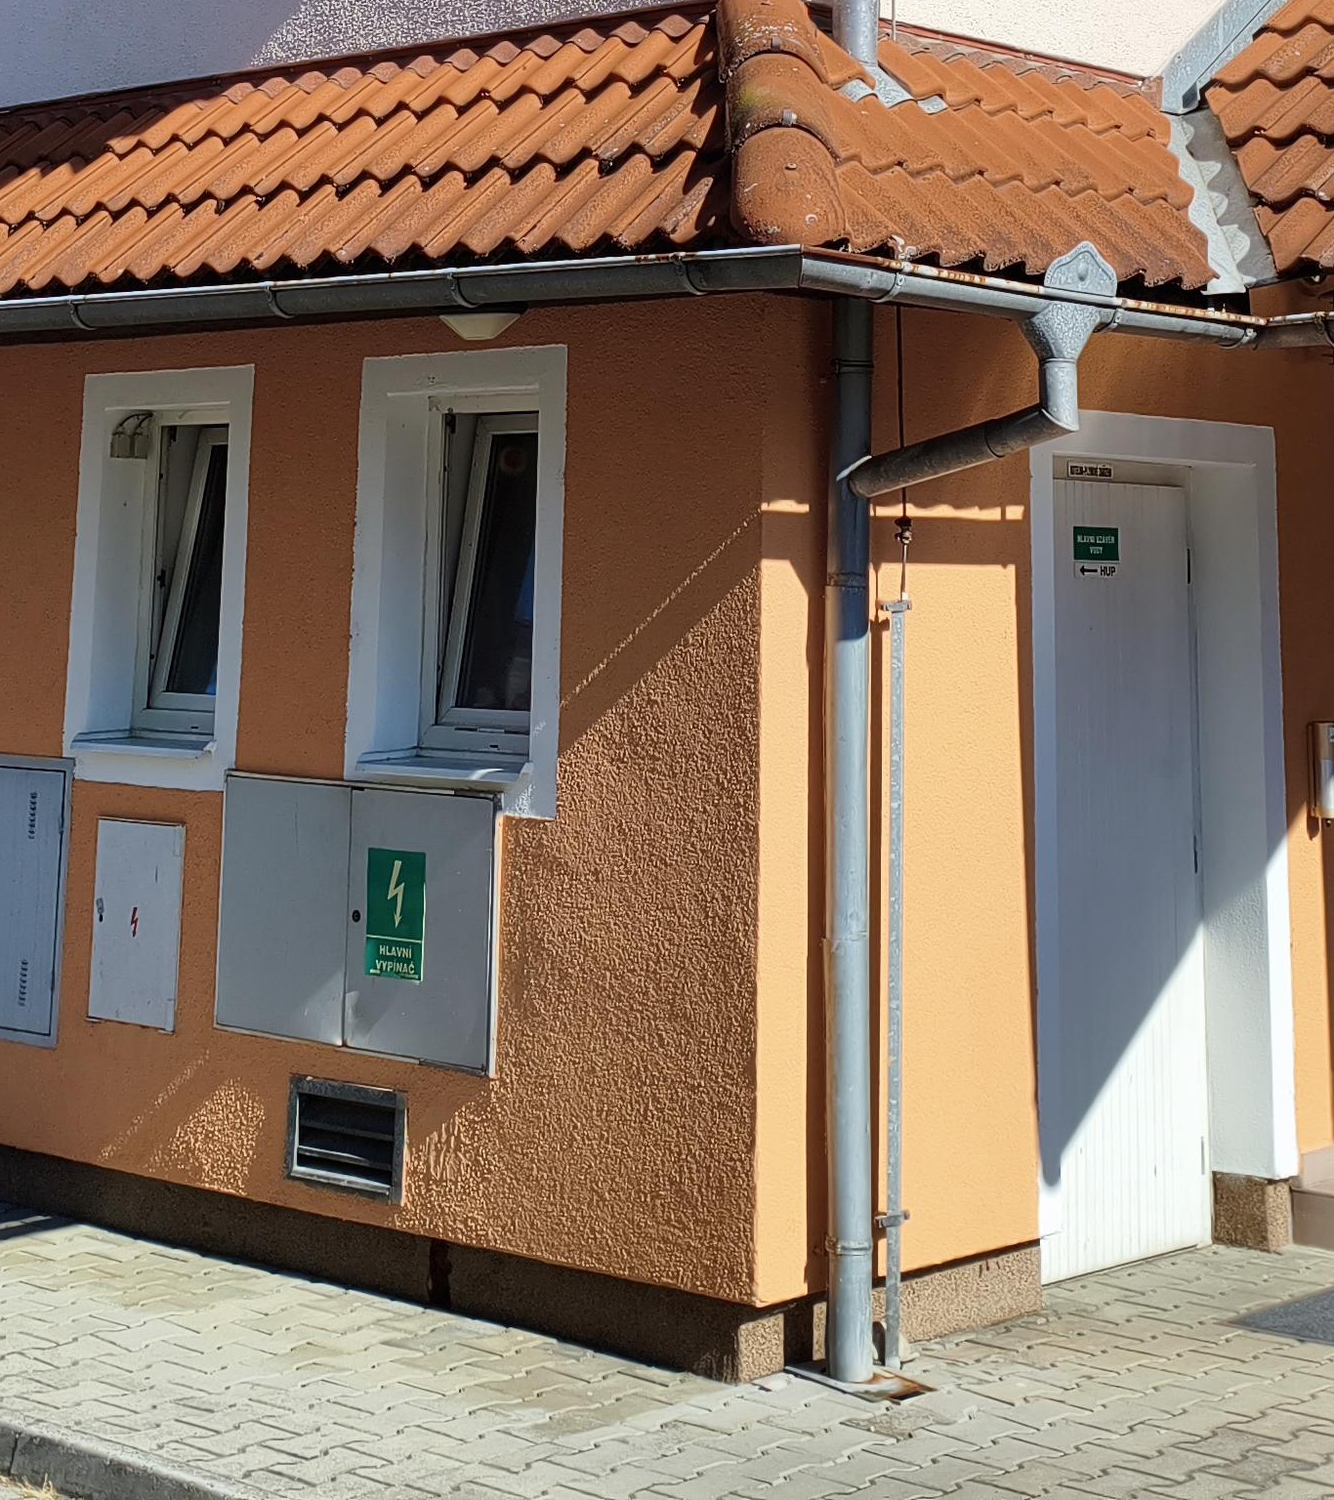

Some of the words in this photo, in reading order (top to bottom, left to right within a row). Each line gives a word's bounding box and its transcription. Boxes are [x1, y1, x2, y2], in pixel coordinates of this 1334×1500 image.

[1099, 565, 1116, 577] HUP
[379, 944, 412, 959] HLAVNÍ
[375, 959, 415, 974] VYPÍNAČ
